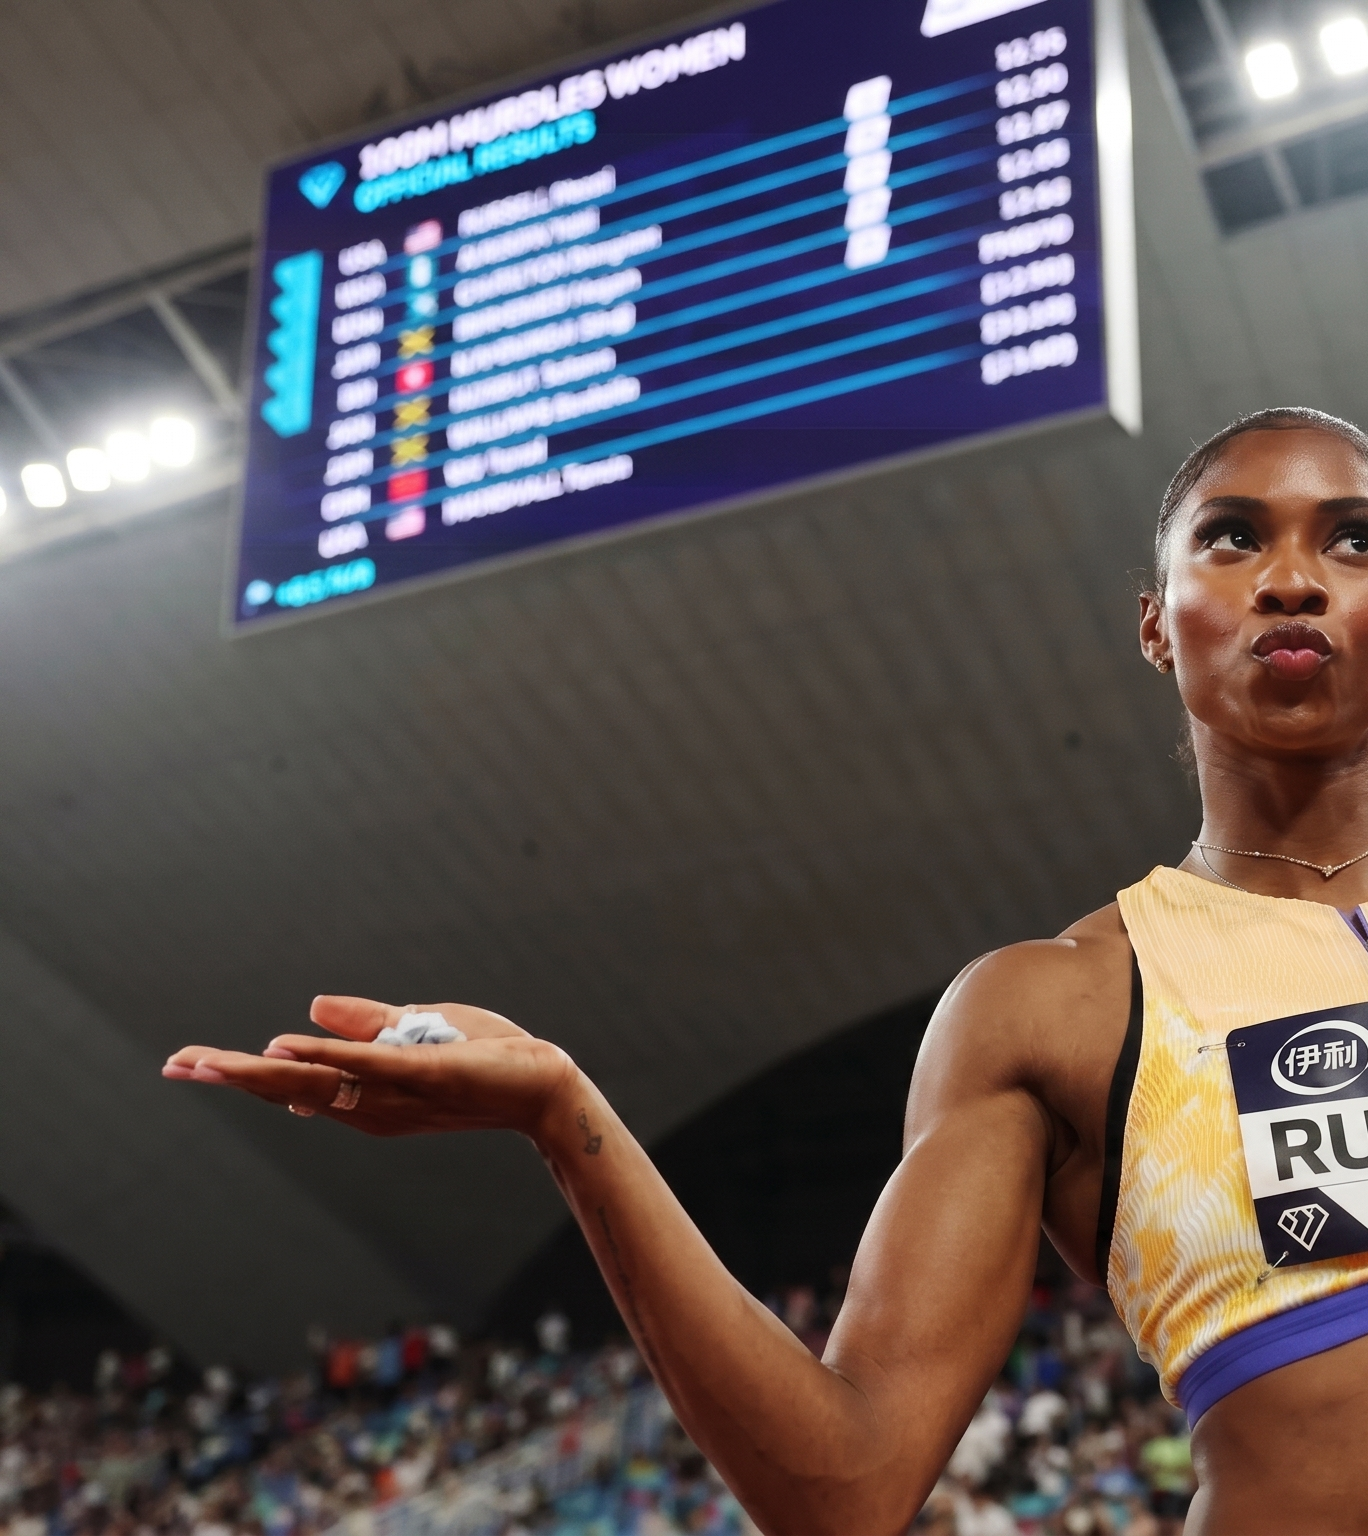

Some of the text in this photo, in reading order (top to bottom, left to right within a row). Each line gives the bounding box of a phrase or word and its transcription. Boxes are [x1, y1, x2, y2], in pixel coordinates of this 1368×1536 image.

[449, 69, 606, 151] HURDLES
[605, 22, 746, 99] WOMEN
[473, 109, 597, 176] RESULTS
[1285, 1039, 1358, 1078] 伊利
